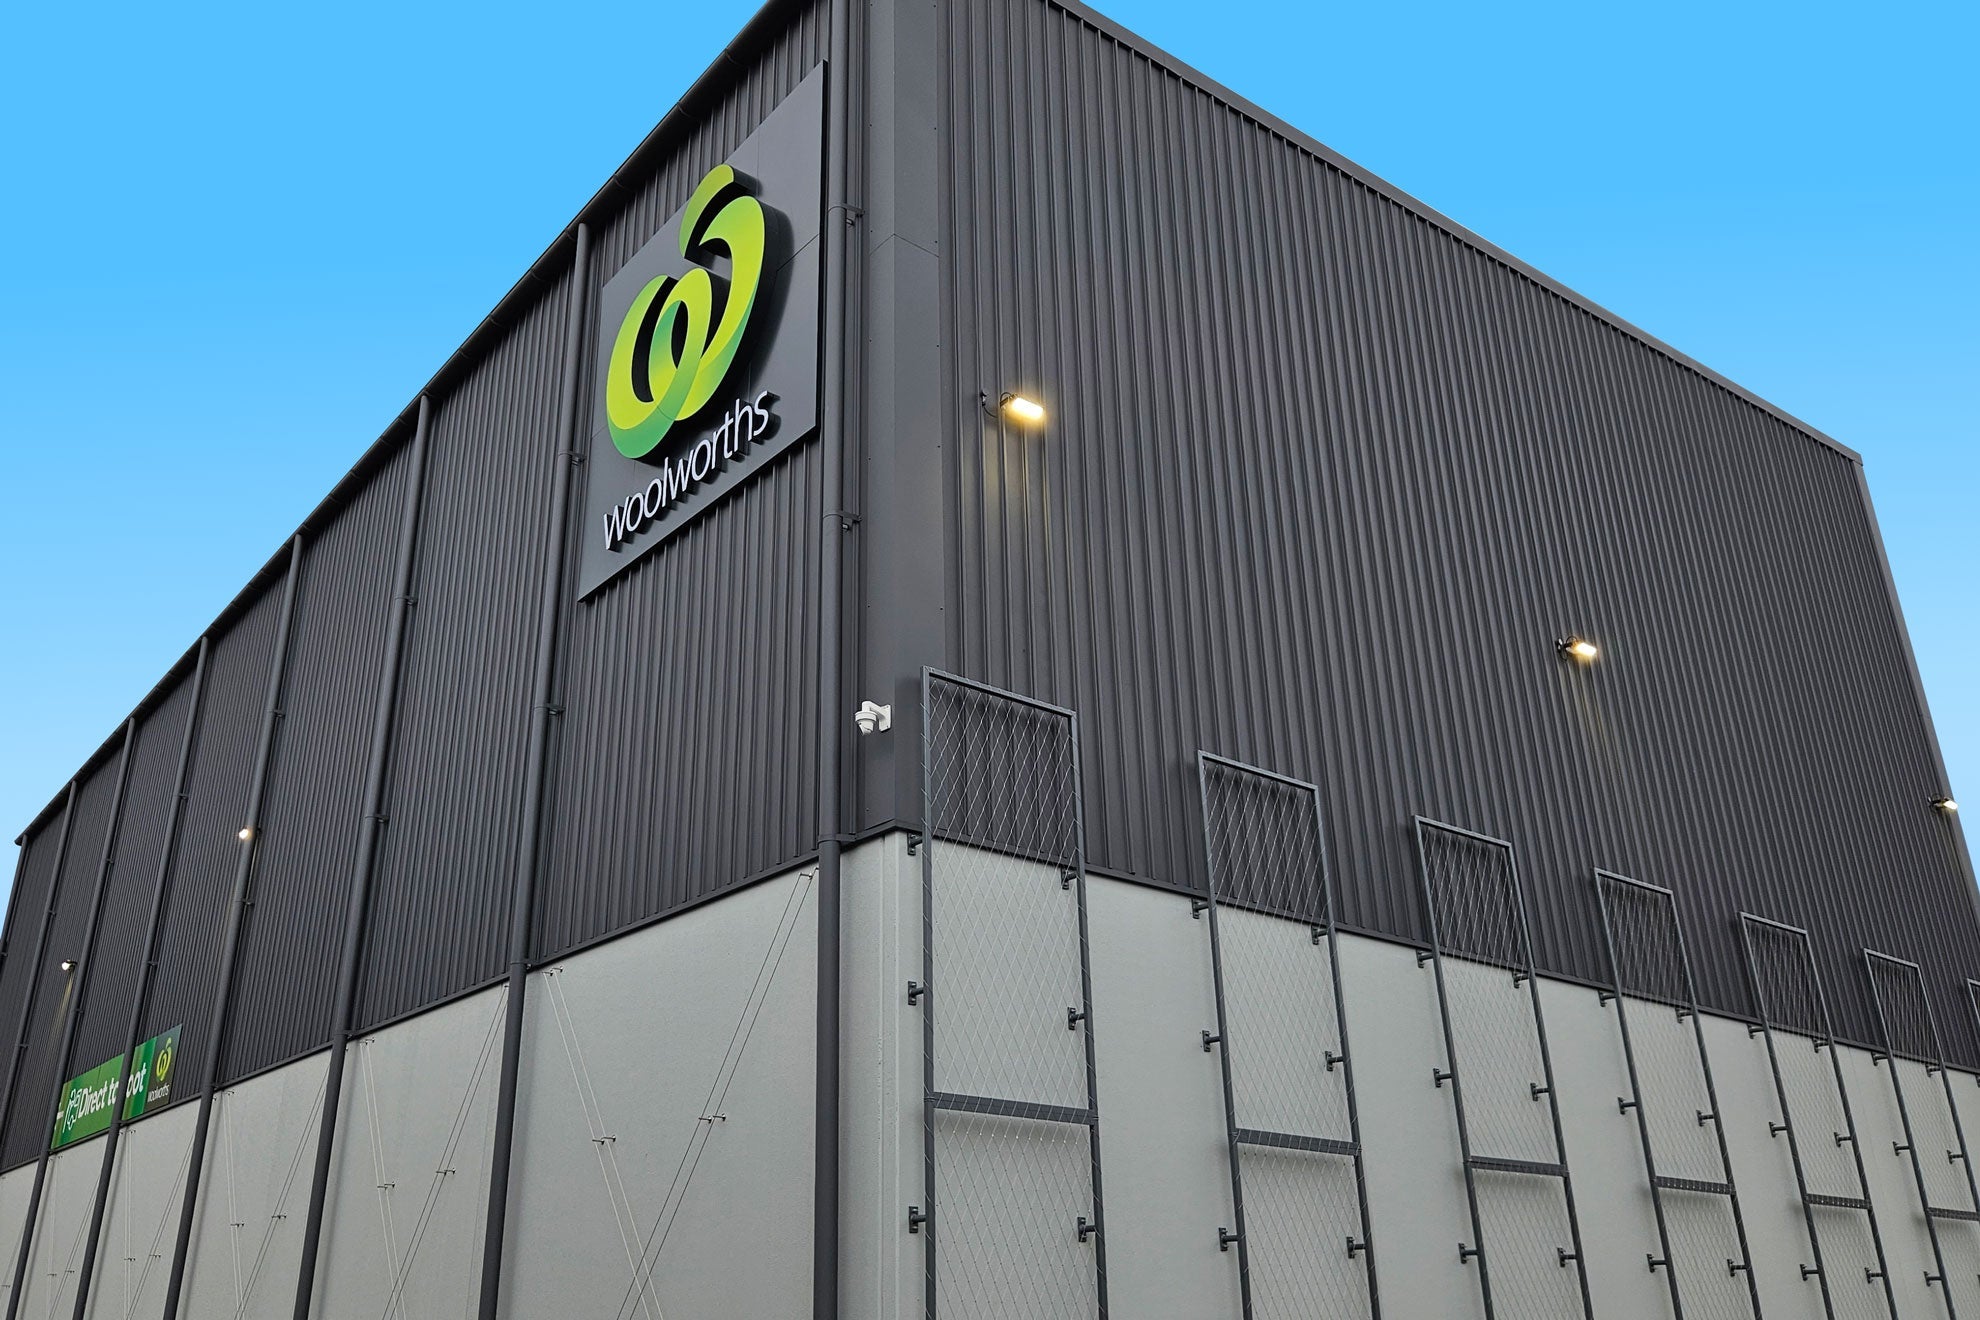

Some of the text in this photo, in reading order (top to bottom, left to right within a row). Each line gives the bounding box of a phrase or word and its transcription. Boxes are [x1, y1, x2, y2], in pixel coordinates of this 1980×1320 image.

[603, 390, 770, 550] woolworths
[78, 1080, 108, 1119] Direct
[124, 1062, 147, 1099] oot
